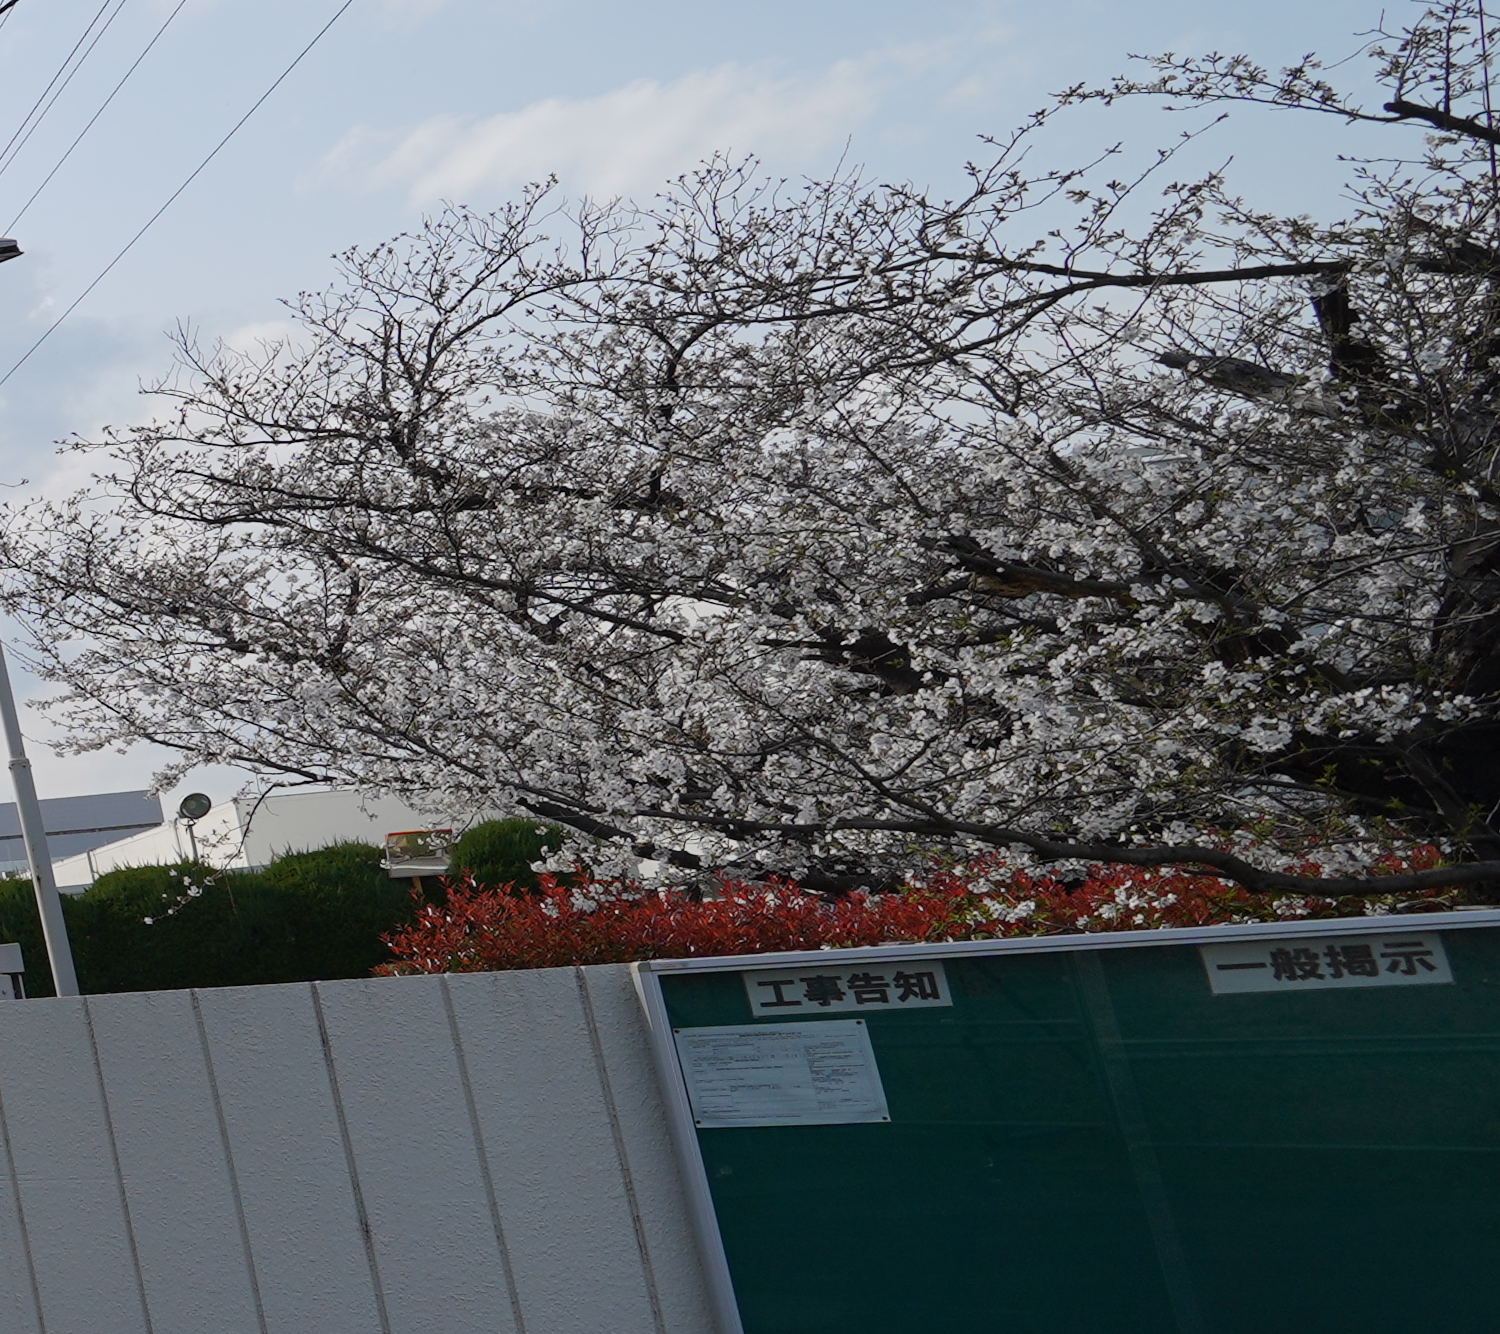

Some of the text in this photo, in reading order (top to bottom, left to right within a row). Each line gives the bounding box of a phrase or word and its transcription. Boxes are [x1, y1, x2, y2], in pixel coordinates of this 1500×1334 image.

[1216, 940, 1438, 982] 一般掲示
[757, 970, 941, 1008] 工事告知
